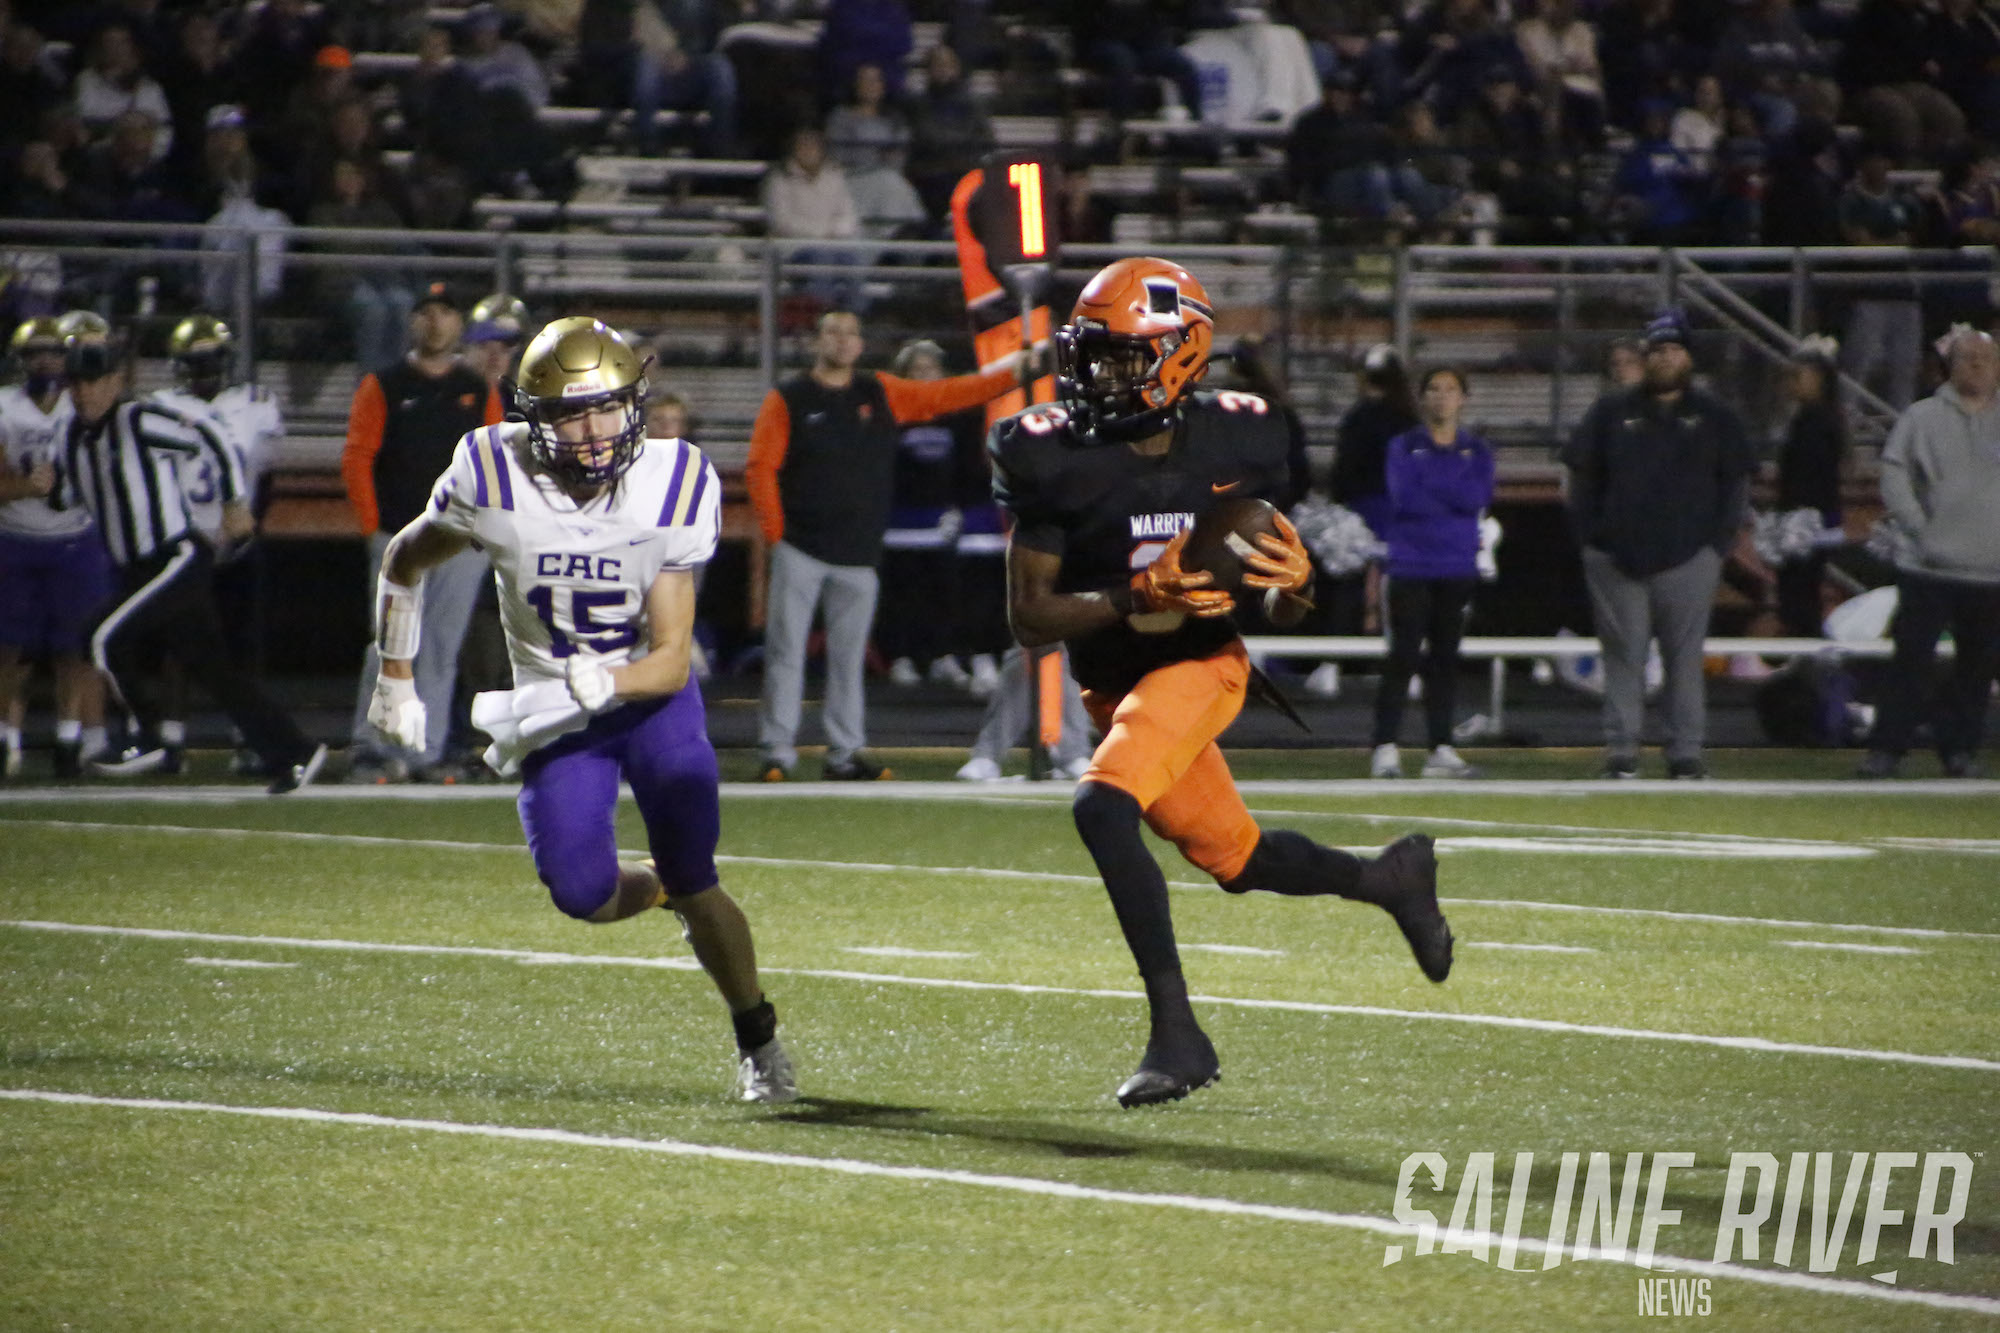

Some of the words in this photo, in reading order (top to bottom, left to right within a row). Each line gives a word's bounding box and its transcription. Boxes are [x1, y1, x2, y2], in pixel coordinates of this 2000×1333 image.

[1008, 163, 1045, 257] 1
[1129, 512, 1195, 537] WARREN
[537, 553, 622, 582] CAC
[526, 585, 640, 659] 15
